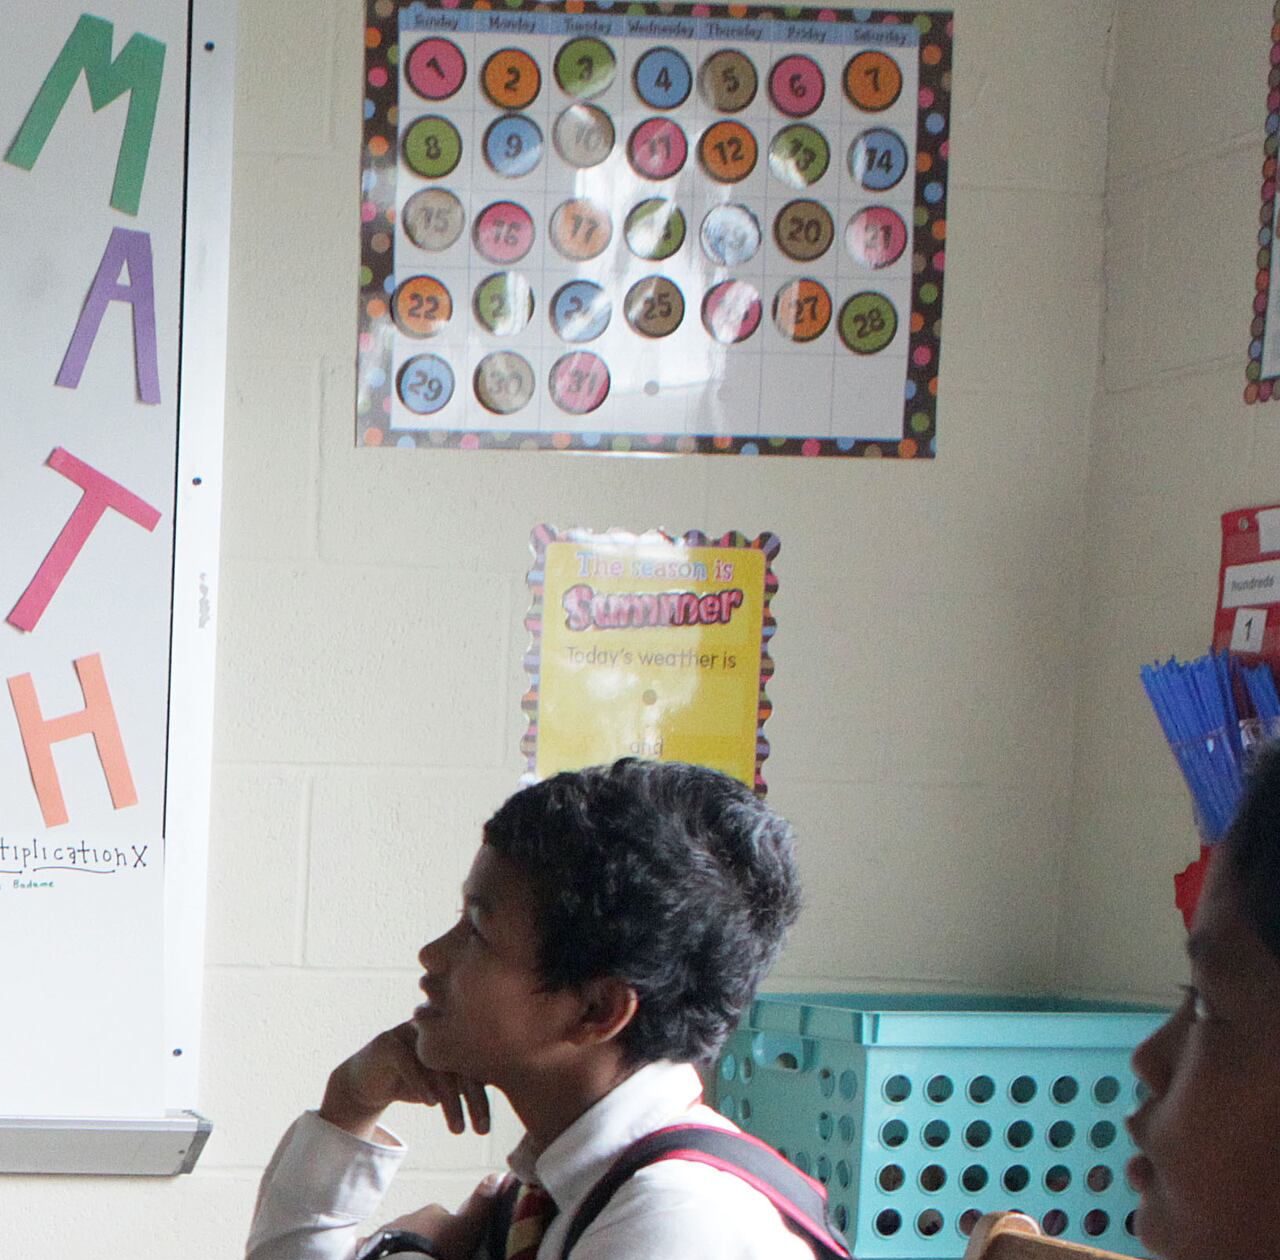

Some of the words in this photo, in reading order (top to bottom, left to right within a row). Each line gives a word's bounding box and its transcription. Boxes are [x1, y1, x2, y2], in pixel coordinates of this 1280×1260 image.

[488, 16, 536, 33] Monday
[563, 18, 612, 35] Tuesday
[627, 20, 695, 38] Wednesday
[706, 22, 764, 41] Thursday
[426, 55, 445, 80] 1
[503, 66, 521, 92] 2
[576, 54, 595, 81] 3
[654, 66, 672, 93] 4
[721, 66, 740, 94] 5
[789, 73, 807, 99] 6
[863, 66, 882, 92] 7
[424, 133, 441, 161] 8
[505, 133, 524, 161] 9
[712, 136, 745, 166] 12
[864, 145, 895, 175] 14
[420, 205, 450, 234] 15
[492, 219, 521, 247] 16
[571, 214, 600, 245] 17
[788, 215, 822, 244] 20
[407, 292, 441, 321] 22
[643, 292, 673, 320] 25
[852, 307, 886, 339] 28
[408, 369, 444, 402] 29
[631, 560, 708, 581] season
[713, 559, 736, 582] is
[561, 584, 744, 632] Summer
[1244, 616, 1254, 641] 1
[566, 646, 633, 669] Today's
[639, 651, 716, 670] weather
[721, 651, 737, 670] is
